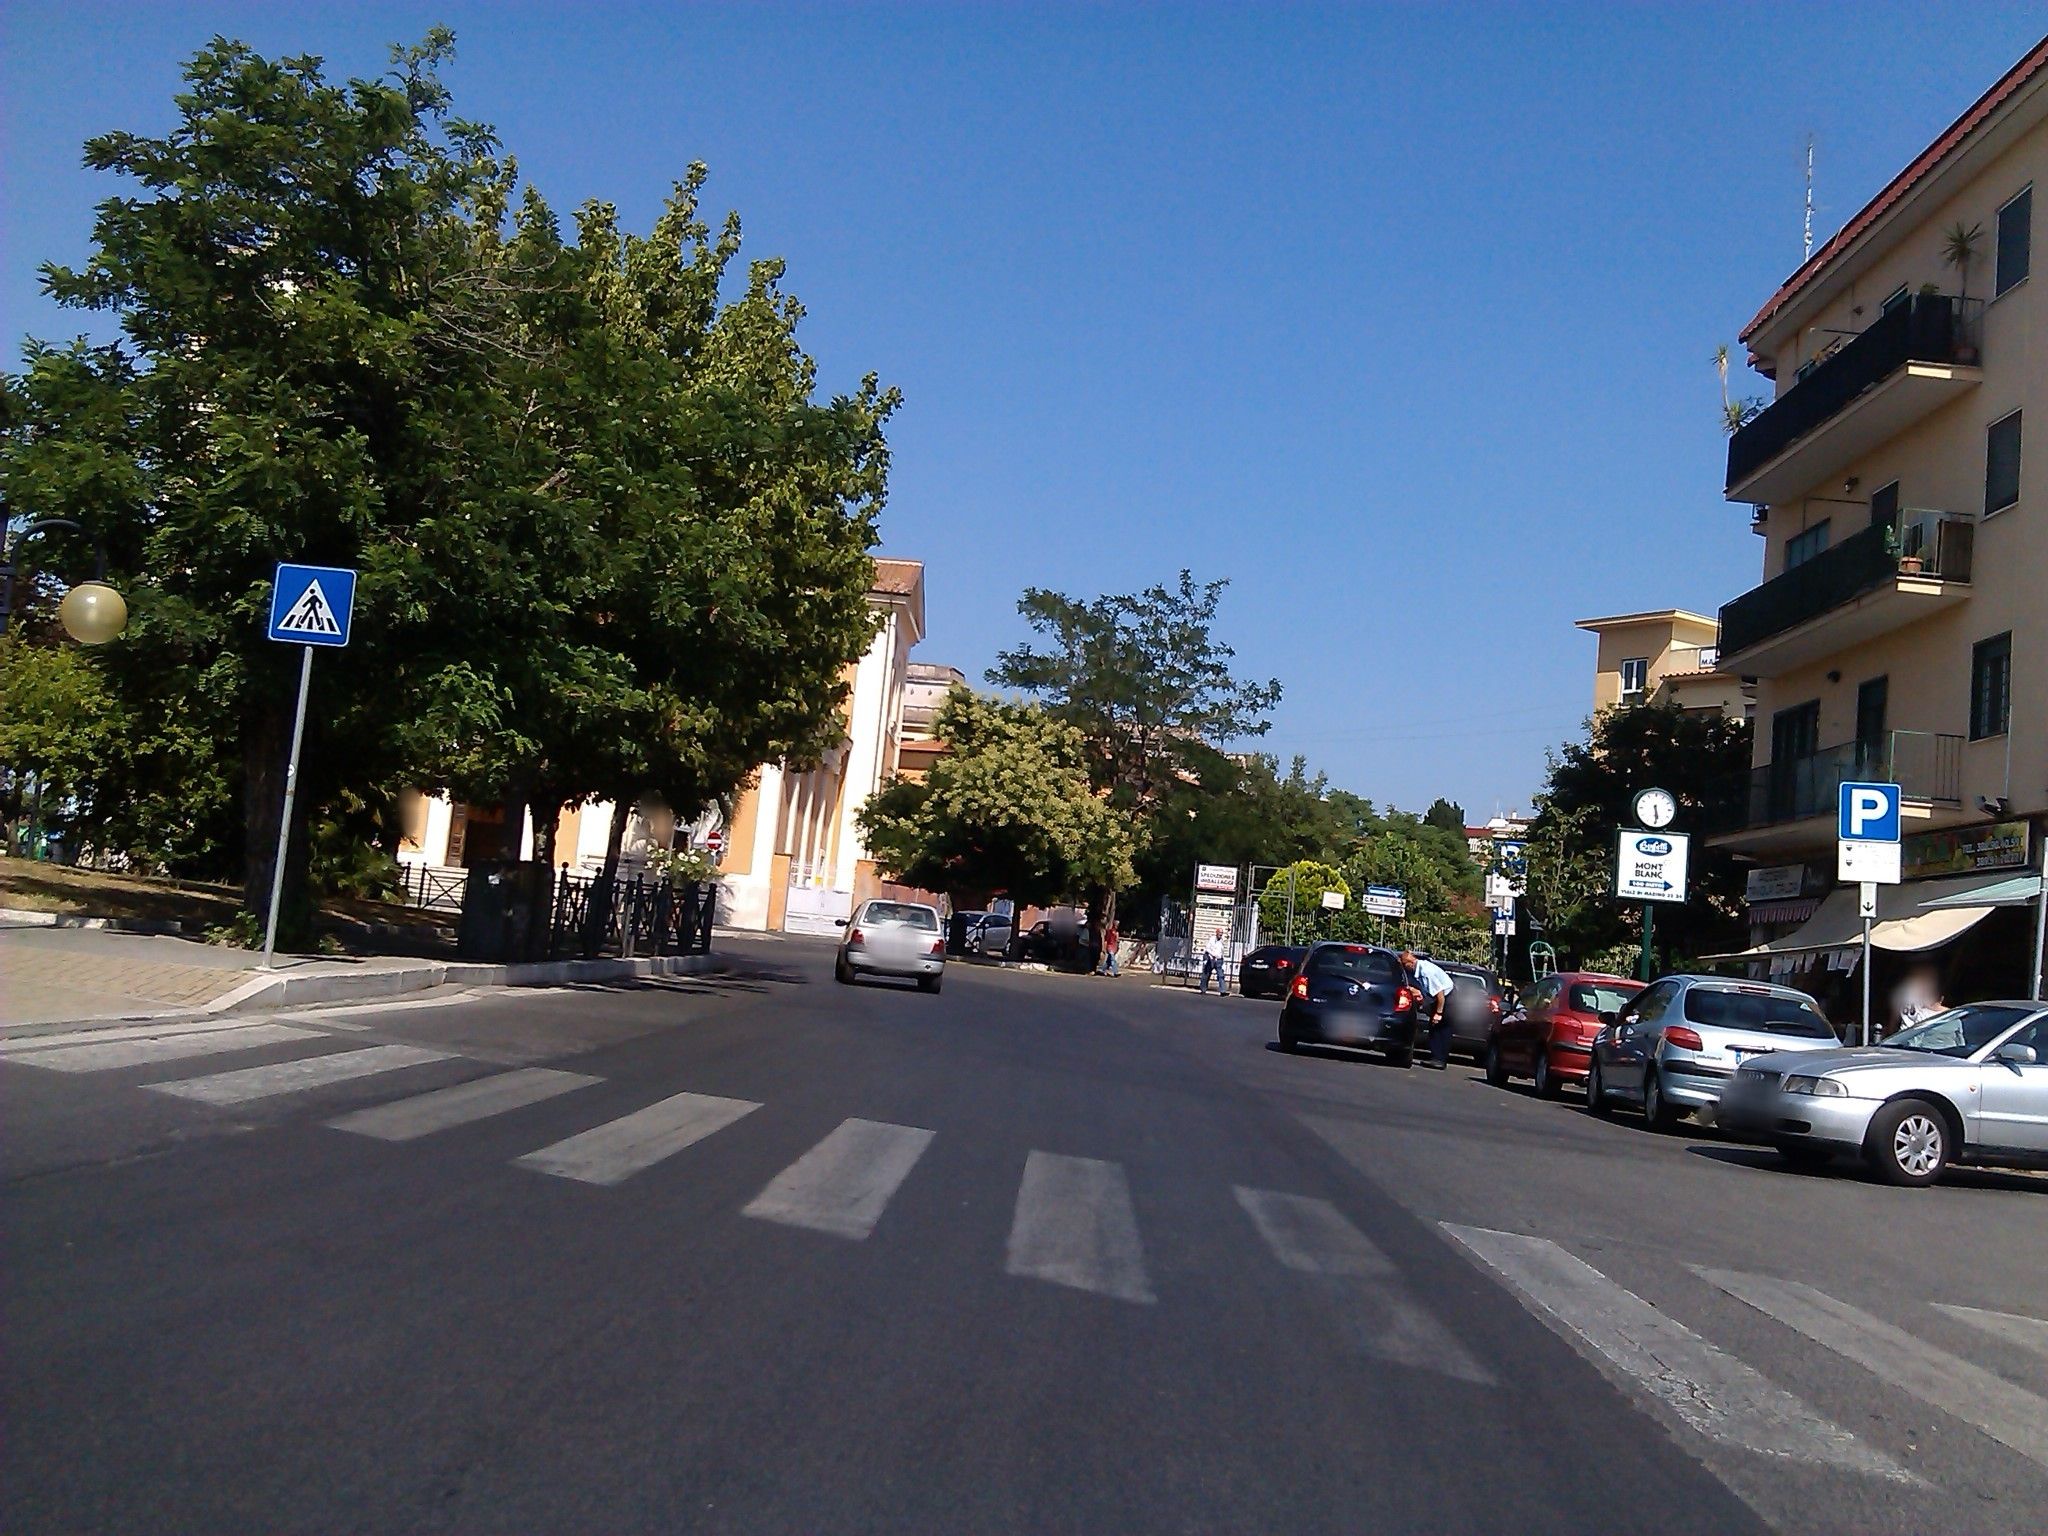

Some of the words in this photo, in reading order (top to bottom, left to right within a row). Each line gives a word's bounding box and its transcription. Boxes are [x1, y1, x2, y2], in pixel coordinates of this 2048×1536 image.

[1850, 788, 1889, 835] P
[1635, 862, 1663, 870] MONT
[1635, 870, 1663, 879] BLANC
